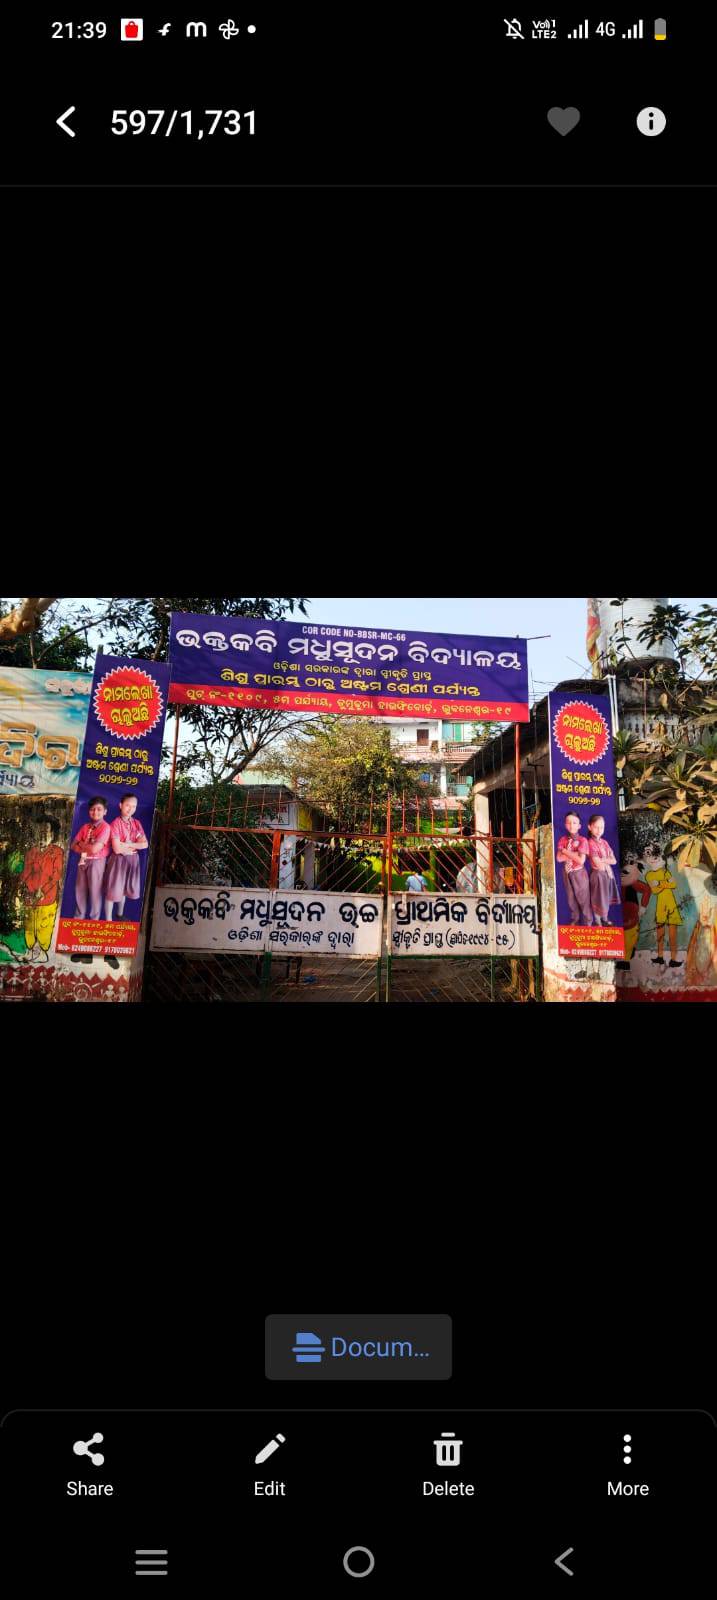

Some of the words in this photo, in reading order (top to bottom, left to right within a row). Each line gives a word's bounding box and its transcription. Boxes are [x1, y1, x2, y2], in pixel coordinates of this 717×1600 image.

[51, 21, 107, 39] 21:39
[595, 21, 616, 37] 4G
[111, 109, 256, 140] 597/1,731
[302, 625, 318, 635] COR
[320, 627, 342, 637] CODE
[175, 629, 278, 653] ଭକ୍ତକବି
[287, 637, 399, 664] ମଧୁସୂଦନ
[407, 640, 522, 670] ବିଦ୍ୟାଳୟ
[220, 667, 250, 685] ଶିଶୁ
[304, 677, 337, 691] ଠାରୁ
[340, 679, 382, 692] ଅଷ୍ଟମ
[386, 681, 428, 695] ଶ୍ରେଣୀ
[103, 685, 153, 702] ନାମଲେଖା
[163, 890, 231, 926] ଭକ୍ତକବି
[239, 898, 326, 929] ମଧୁସୂଦନ
[338, 901, 379, 928] ଉଚ୍ଚ
[394, 897, 468, 925] ପ୍ରାଥମିକ
[227, 926, 263, 943] ଓଡ଼ିଶା
[66, 1480, 114, 1496] Share
[254, 1480, 286, 1496] Edit
[423, 1480, 475, 1496] Delete
[607, 1481, 650, 1496] More
